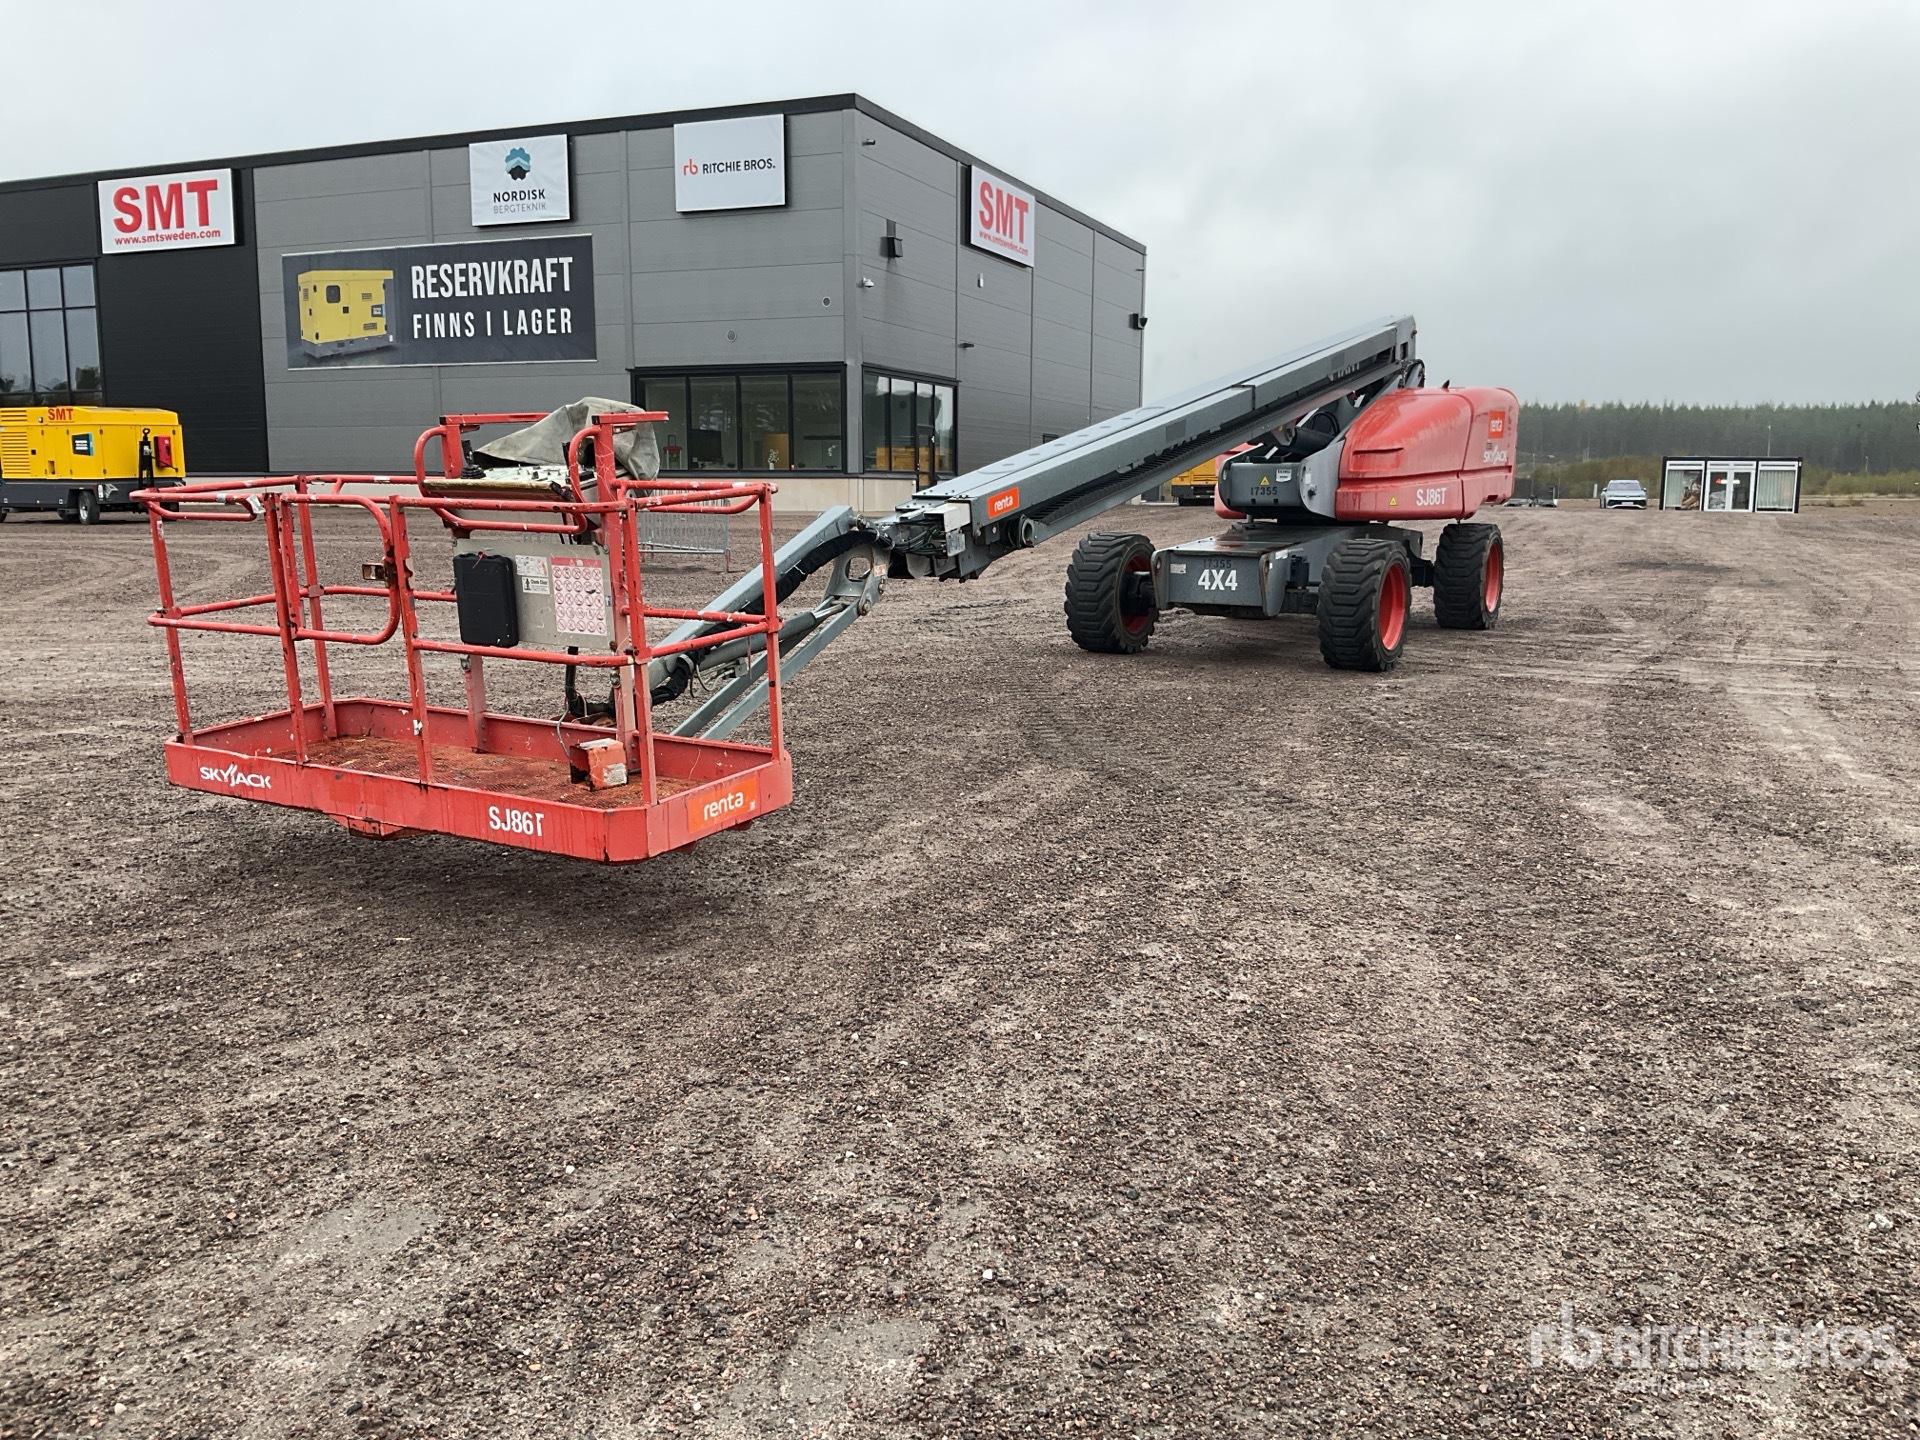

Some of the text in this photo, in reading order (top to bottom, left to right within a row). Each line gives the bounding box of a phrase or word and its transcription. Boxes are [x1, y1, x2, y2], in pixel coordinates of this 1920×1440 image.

[683, 157, 776, 176] rb RITCHIE BROS.
[493, 188, 546, 203] NORDISK
[112, 179, 218, 233] SMT
[493, 202, 547, 214] BERGTEKNIK
[979, 181, 1028, 244] SMT
[114, 229, 221, 245] www.smtsweden.com
[411, 256, 573, 299] RESERVKRAFT
[412, 307, 572, 339] FINNS I LAGER
[48, 408, 73, 421] SMT
[1250, 486, 1278, 496] 17355
[1416, 487, 1447, 506] SJ86T
[993, 495, 1014, 513] renta
[1197, 569, 1238, 591] 4X4
[200, 763, 272, 789] SKYJACK
[703, 791, 744, 821] renta
[488, 805, 545, 837] SJ86T
